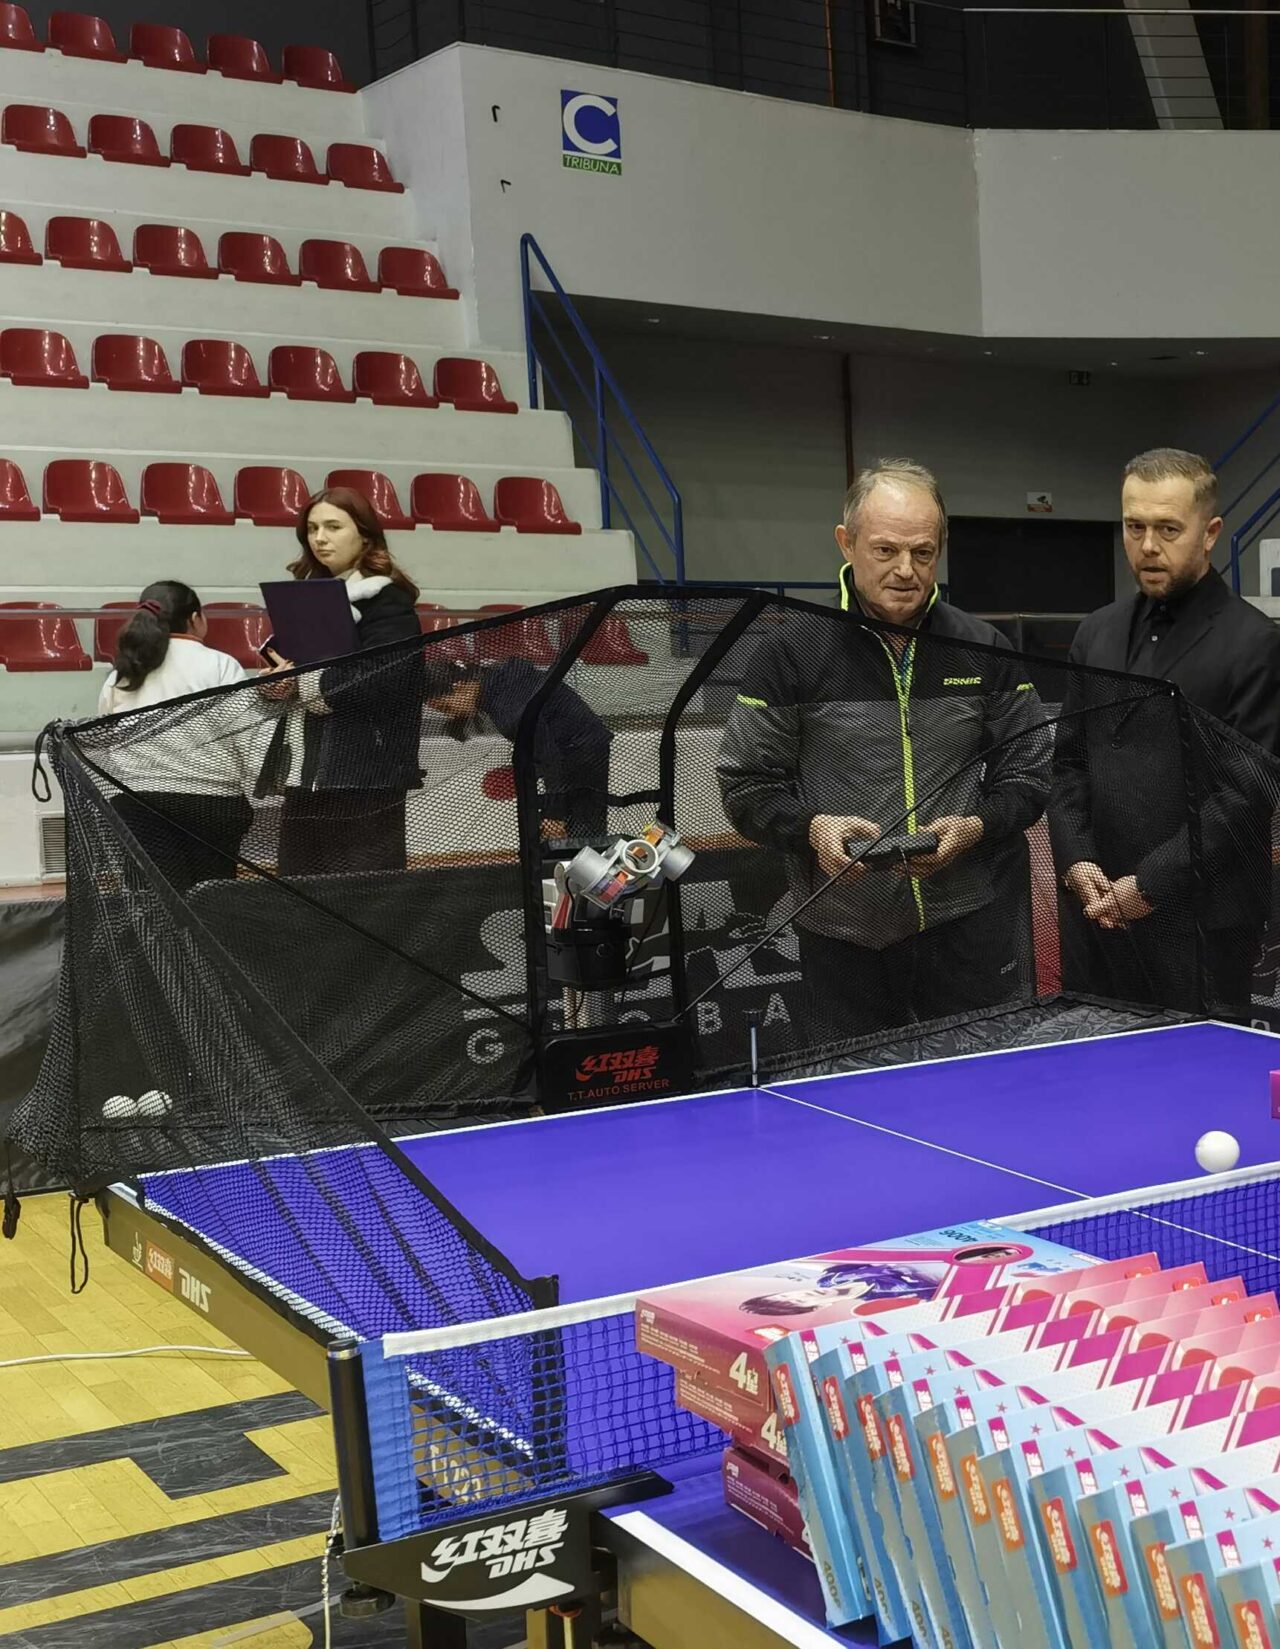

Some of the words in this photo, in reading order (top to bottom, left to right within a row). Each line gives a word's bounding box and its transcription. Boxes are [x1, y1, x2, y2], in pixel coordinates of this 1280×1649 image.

[563, 94, 618, 155] C
[563, 154, 621, 175] TRIBUNA
[578, 1045, 660, 1077] 红双喜
[612, 1066, 657, 1083] DHS
[623, 1078, 670, 1093] SERVER
[425, 1508, 569, 1574] 红双喜
[485, 1541, 565, 1579] DHS
